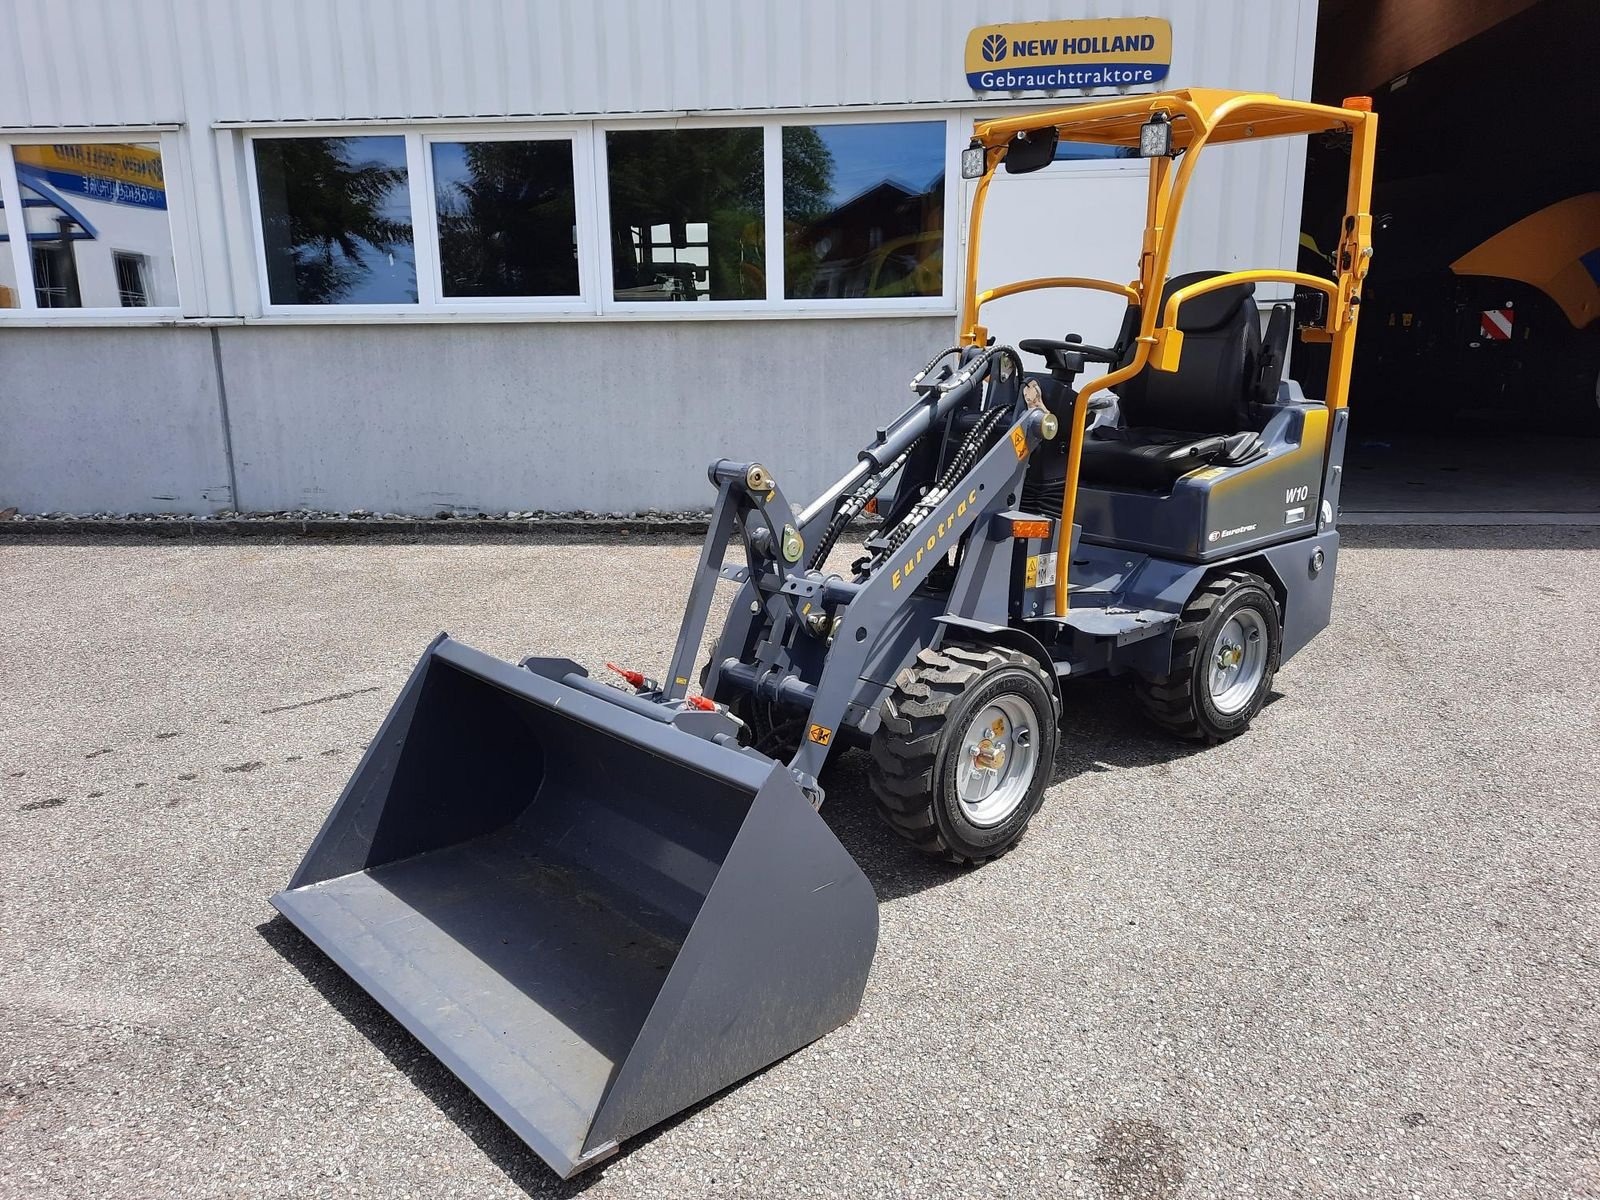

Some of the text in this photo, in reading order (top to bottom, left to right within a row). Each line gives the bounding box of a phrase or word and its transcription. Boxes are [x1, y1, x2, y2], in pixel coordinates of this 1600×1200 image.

[1012, 34, 1155, 57] NEW HOLLAND
[980, 67, 1153, 87] Gebrauchttraktore
[1285, 485, 1309, 504] W10
[892, 489, 976, 591] Eurotrac
[1221, 523, 1258, 538] Eurotrac
